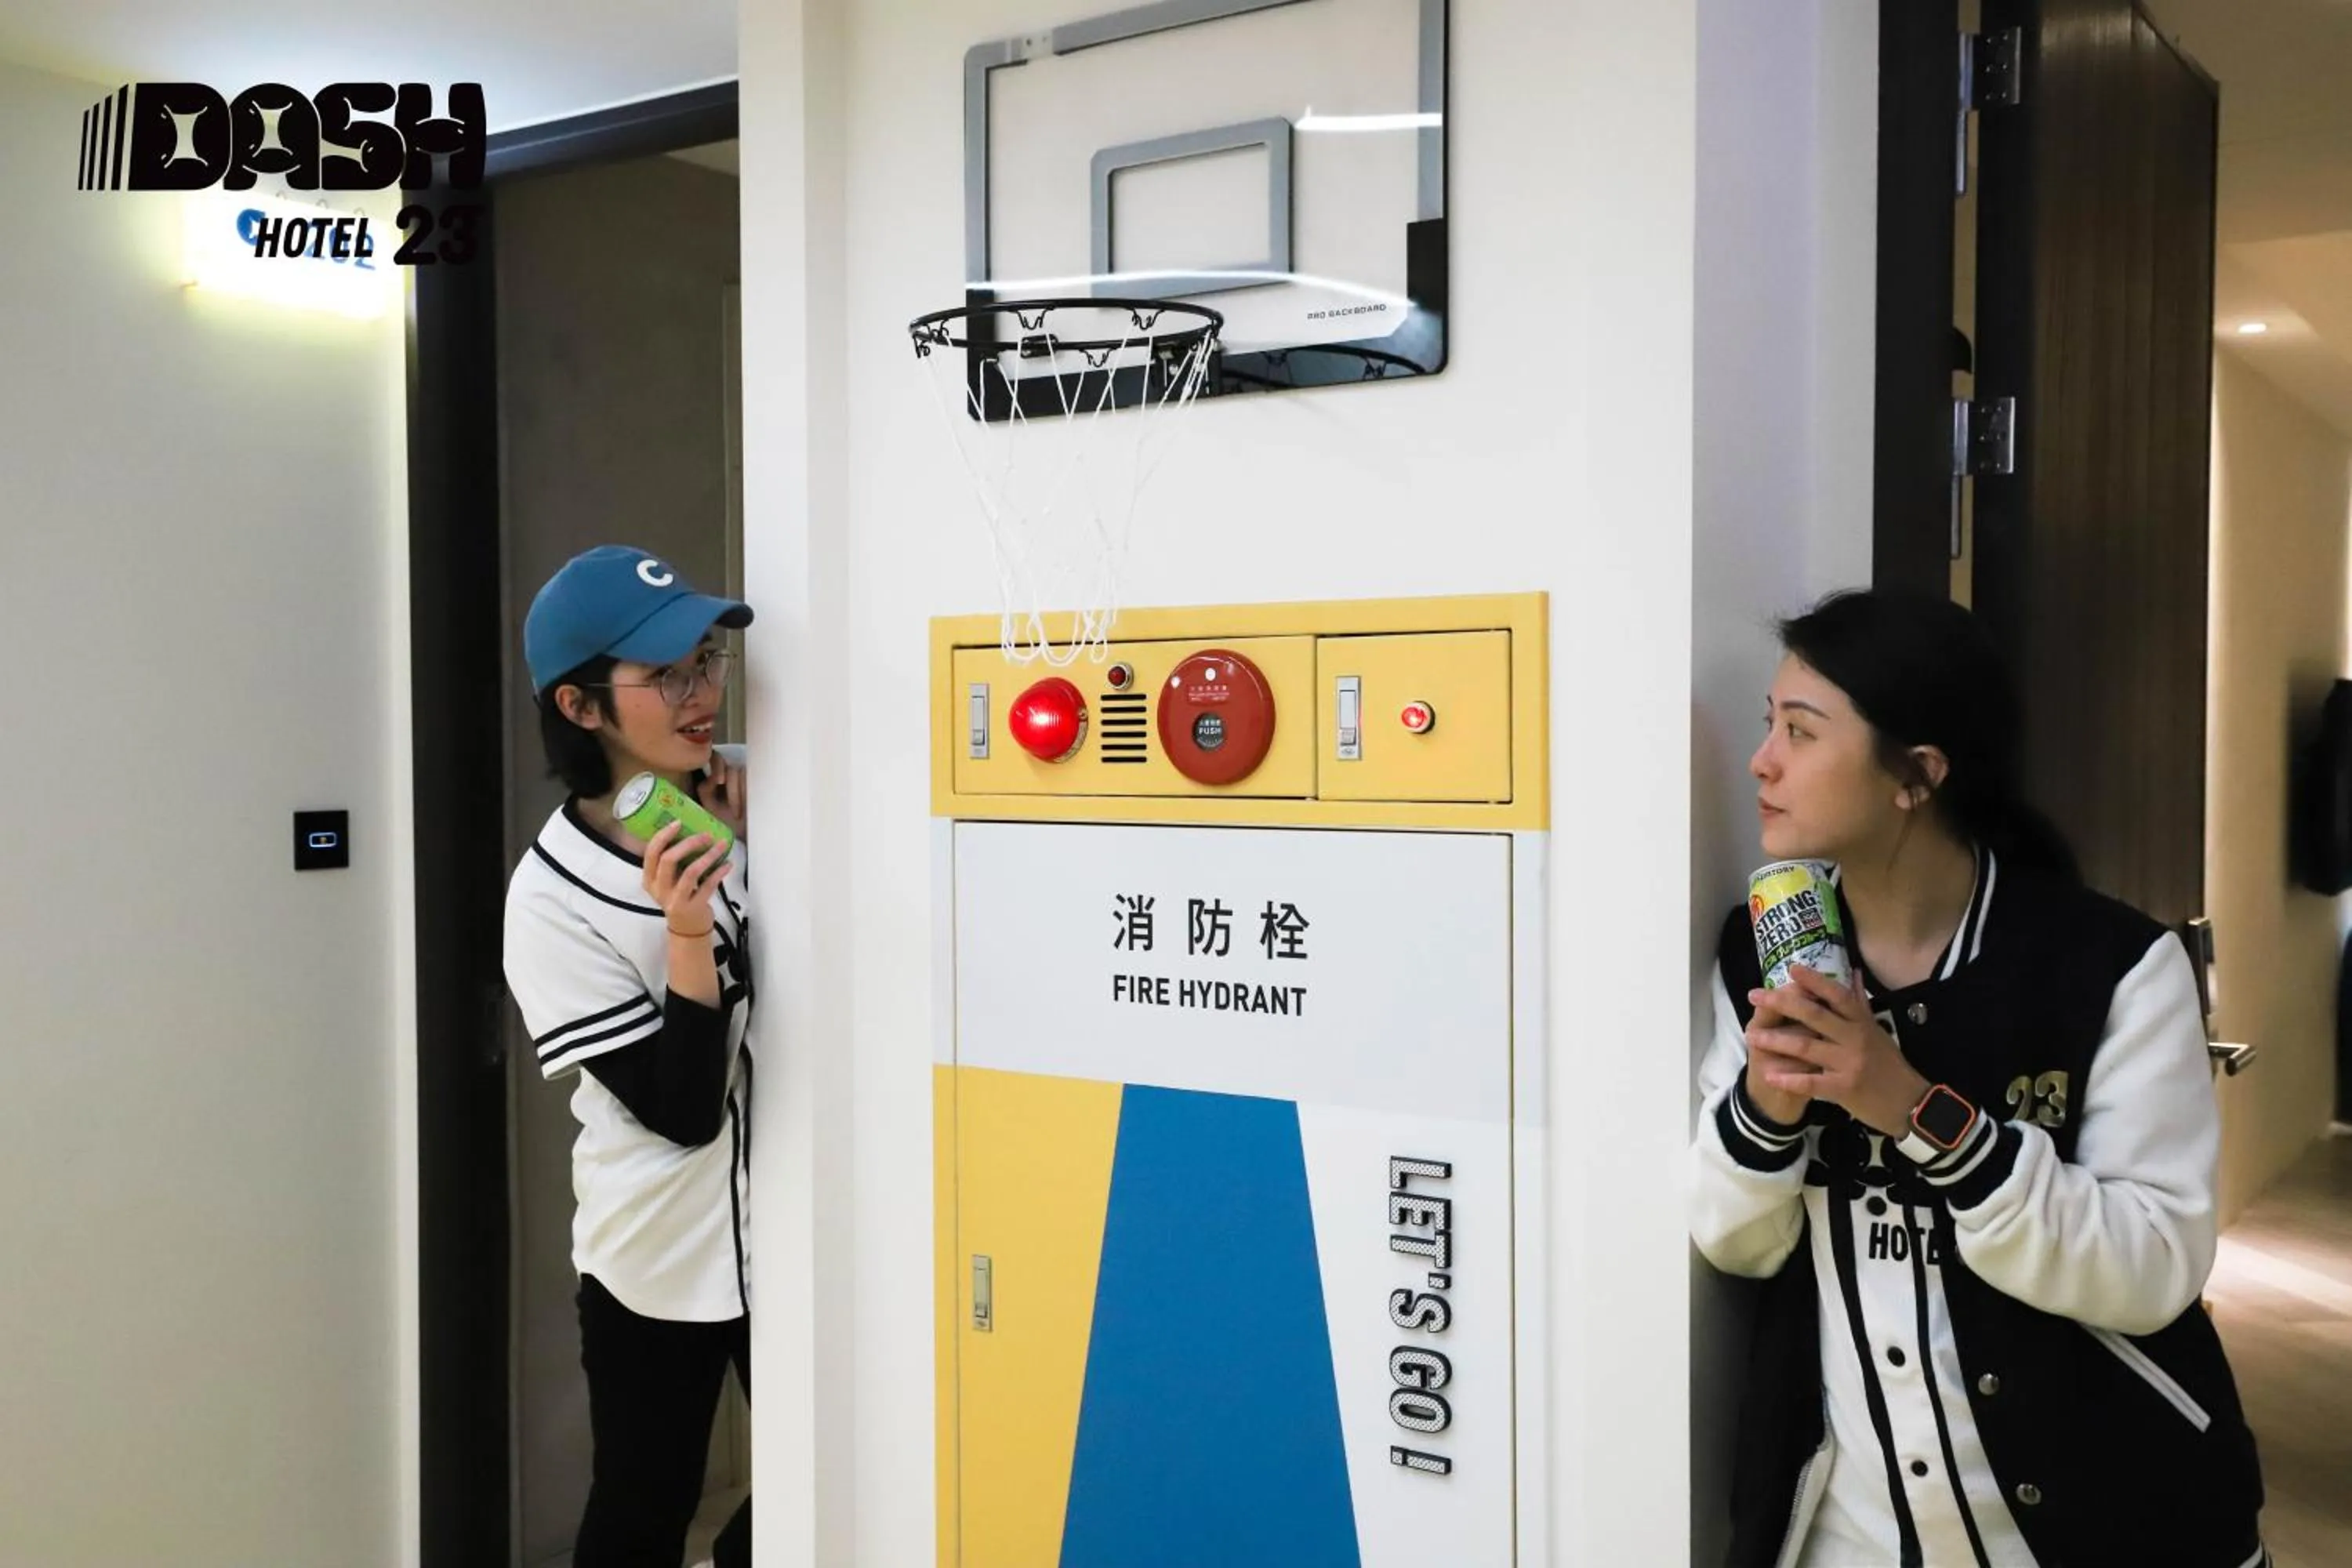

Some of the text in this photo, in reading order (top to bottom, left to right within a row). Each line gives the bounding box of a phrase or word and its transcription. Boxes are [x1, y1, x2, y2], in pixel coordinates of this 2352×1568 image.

[1328, 303, 1387, 318] BACKBOARD
[636, 558, 674, 588] C
[1112, 893, 1310, 960] 消防栓
[1755, 890, 1817, 939] STRONG
[1759, 916, 1802, 954] ZERO
[1113, 975, 1308, 1017] FIRE HYDRANT
[1389, 1156, 1452, 1334] LET'S
[1869, 1222, 1940, 1265] HOTE
